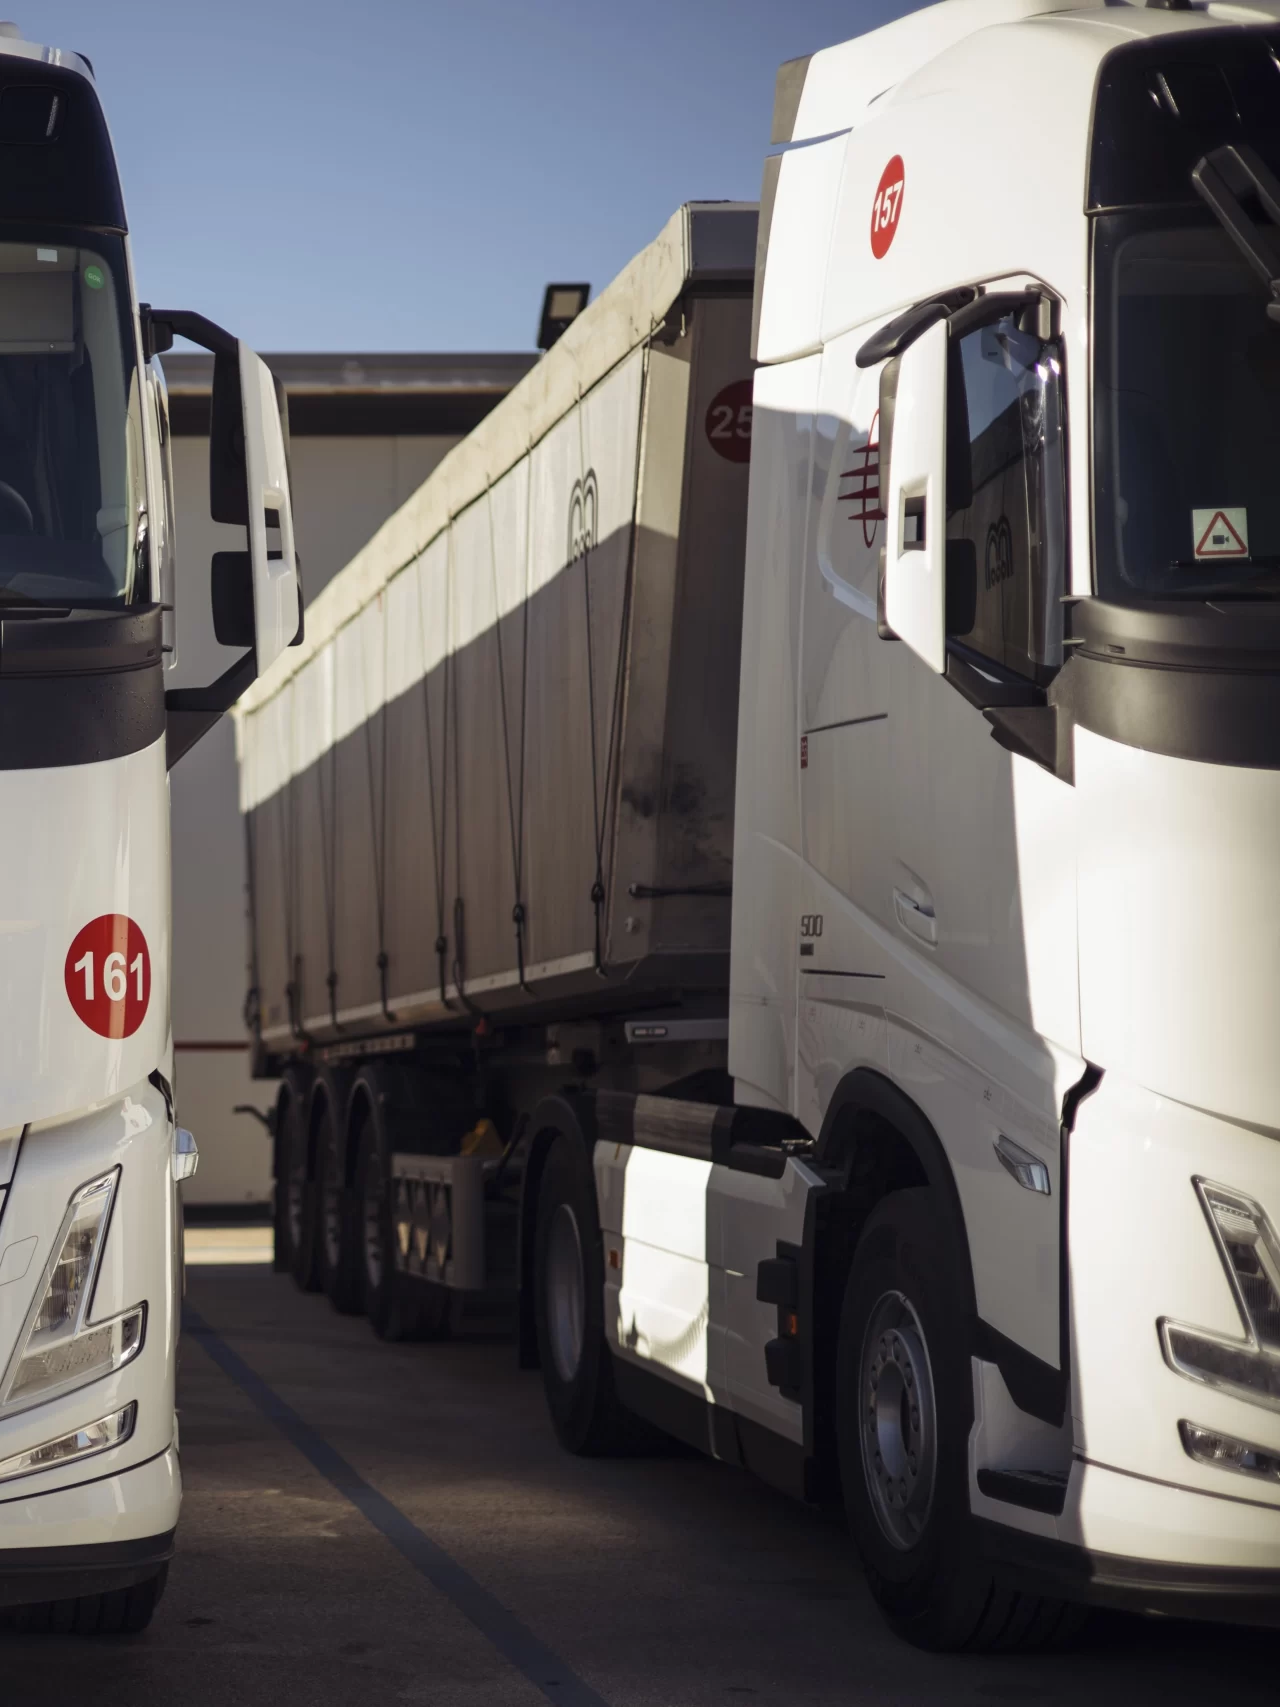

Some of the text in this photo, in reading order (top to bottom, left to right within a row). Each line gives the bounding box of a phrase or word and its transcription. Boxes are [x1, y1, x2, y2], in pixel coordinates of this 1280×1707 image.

[873, 179, 904, 233] 157
[800, 914, 823, 937] 500
[73, 950, 145, 1002] 161
